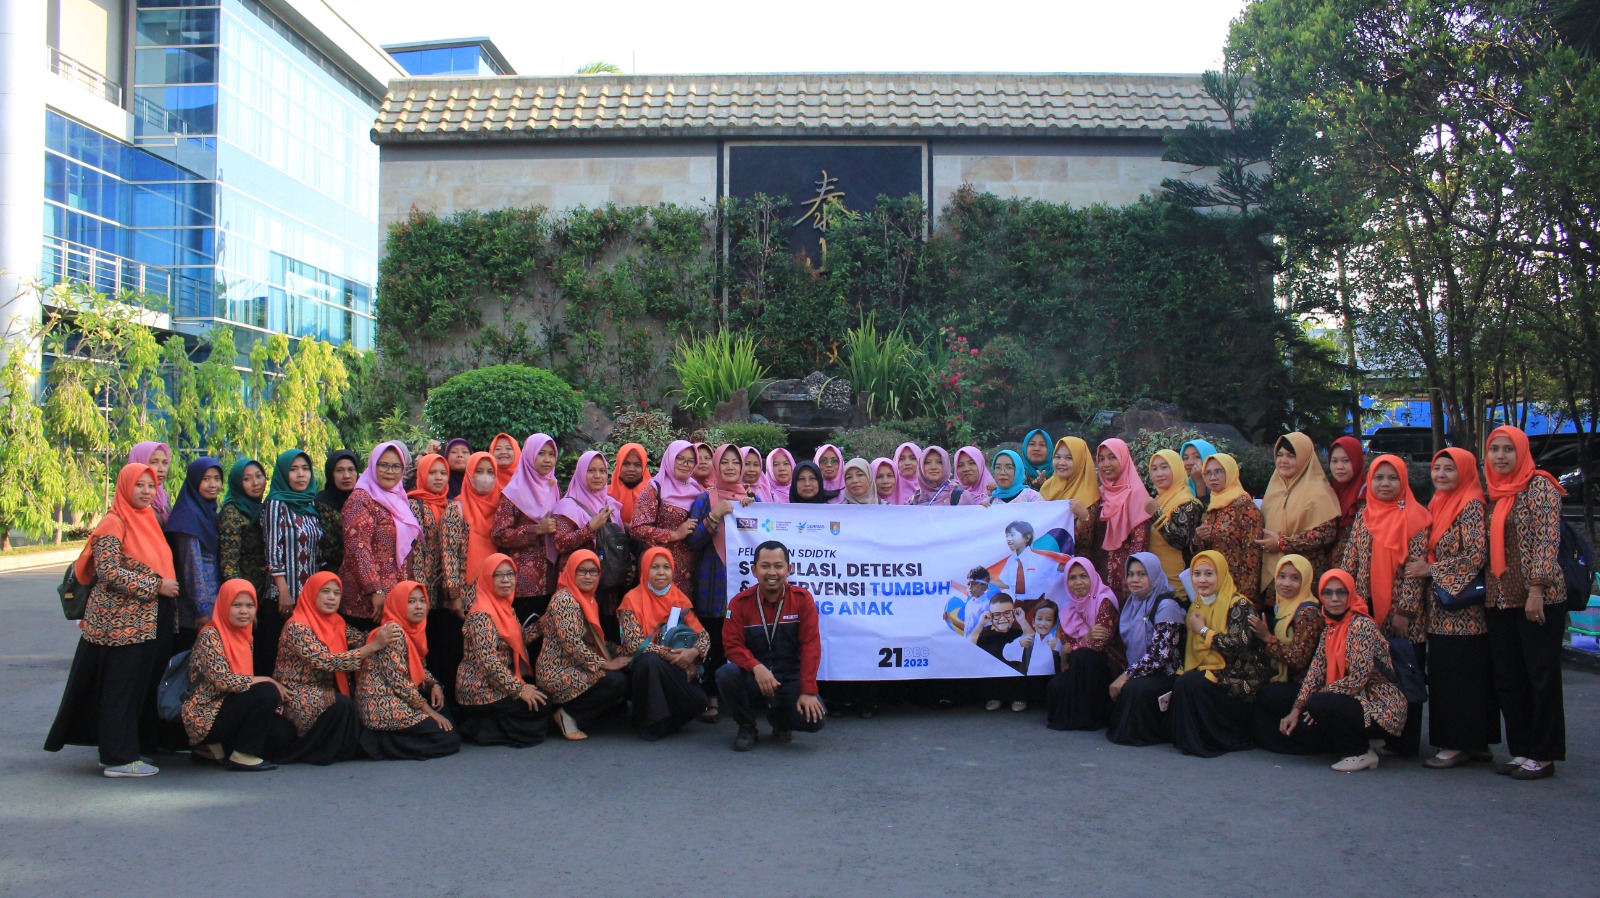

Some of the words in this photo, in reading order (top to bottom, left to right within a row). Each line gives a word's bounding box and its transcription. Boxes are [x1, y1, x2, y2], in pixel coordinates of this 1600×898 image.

[739, 519, 756, 528] S2P
[798, 548, 837, 558] SDIDTK
[846, 562, 923, 577] DETEKSI
[869, 580, 951, 596] TUMBUH
[838, 601, 894, 616] ANAK
[878, 647, 903, 668] 21
[903, 646, 930, 658] DEC
[903, 658, 929, 667] 2023
